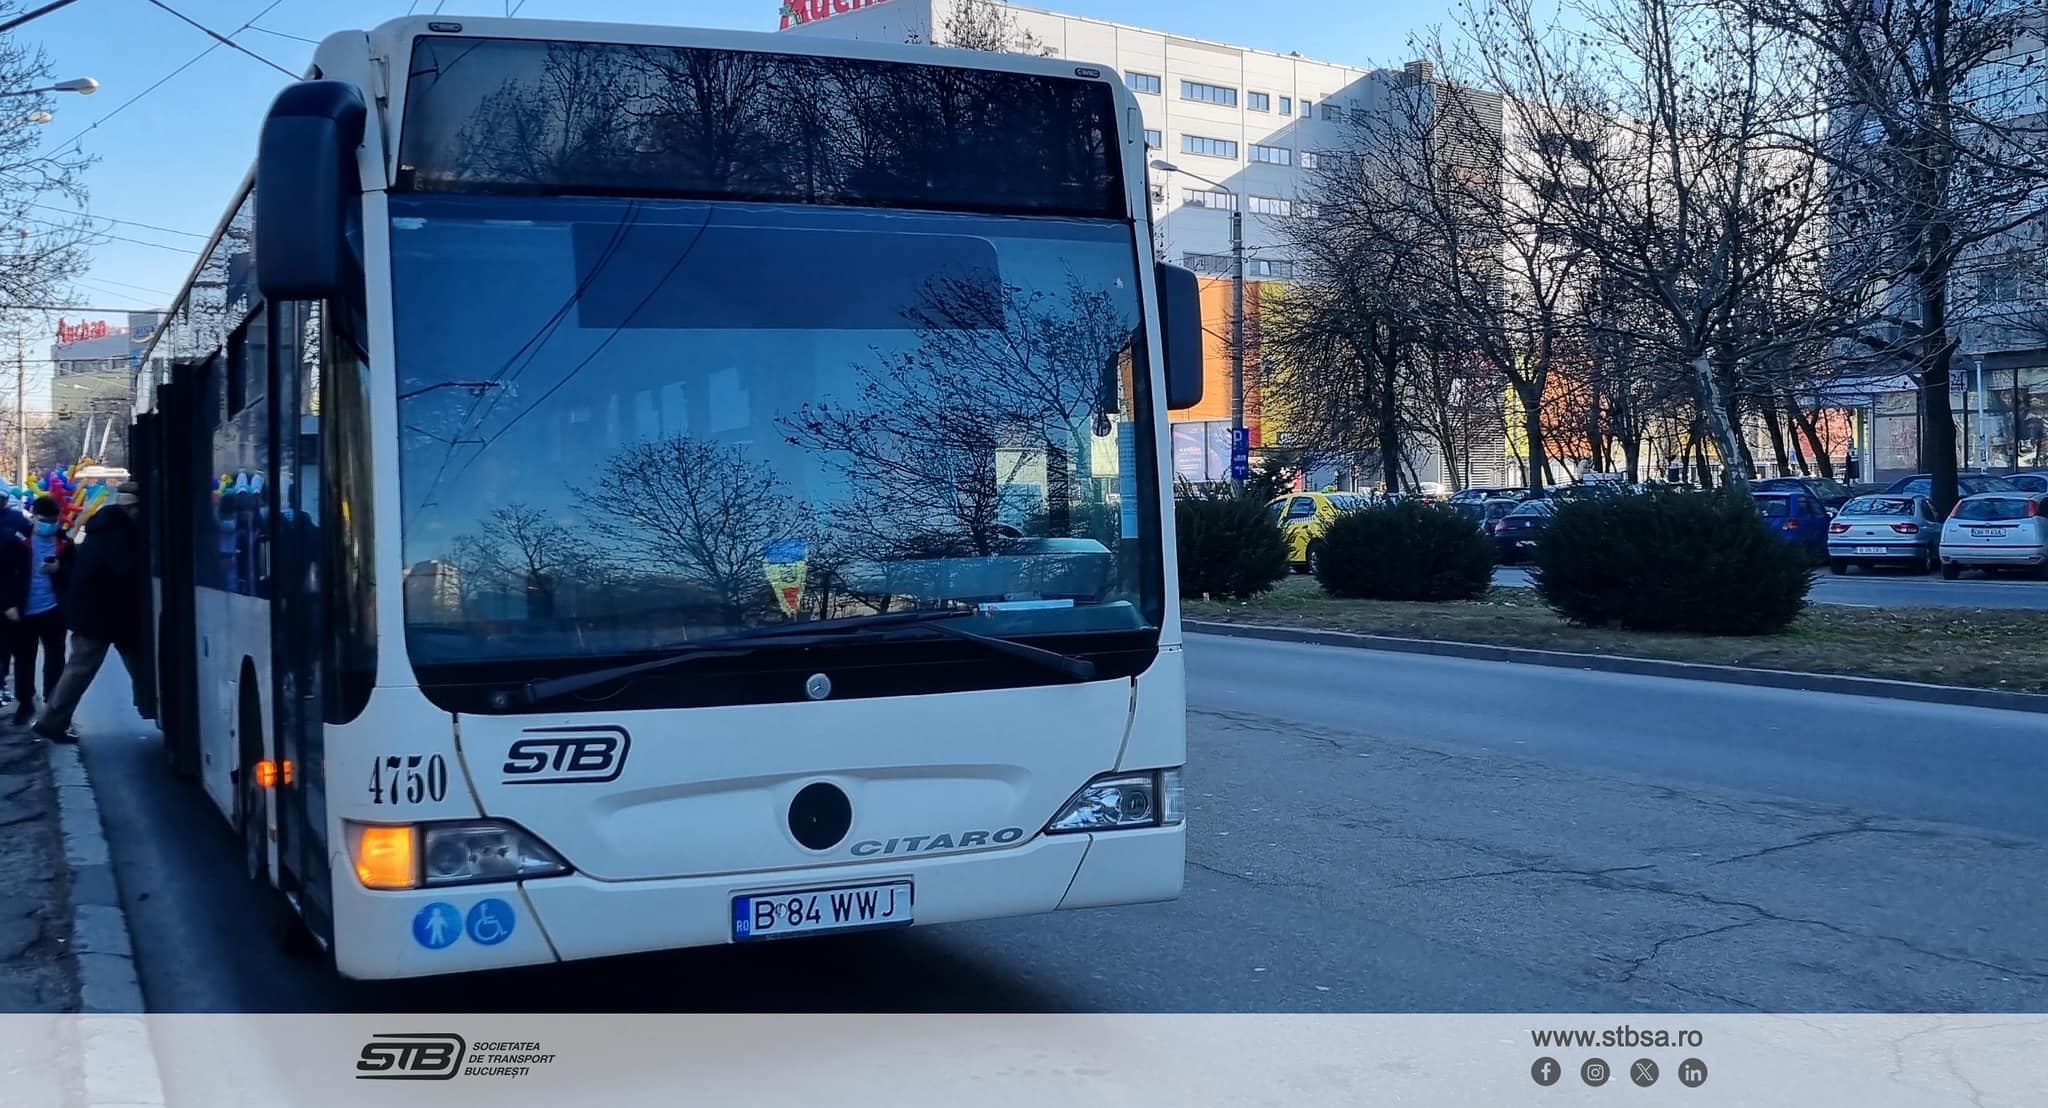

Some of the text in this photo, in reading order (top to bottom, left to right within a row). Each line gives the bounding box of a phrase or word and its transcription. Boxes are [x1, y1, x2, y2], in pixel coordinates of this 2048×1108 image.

[502, 737, 618, 773] STB
[368, 754, 447, 805] 4750
[850, 827, 1024, 856] CITARO
[736, 919, 750, 933] RO
[755, 888, 895, 930] B 84 WWJ
